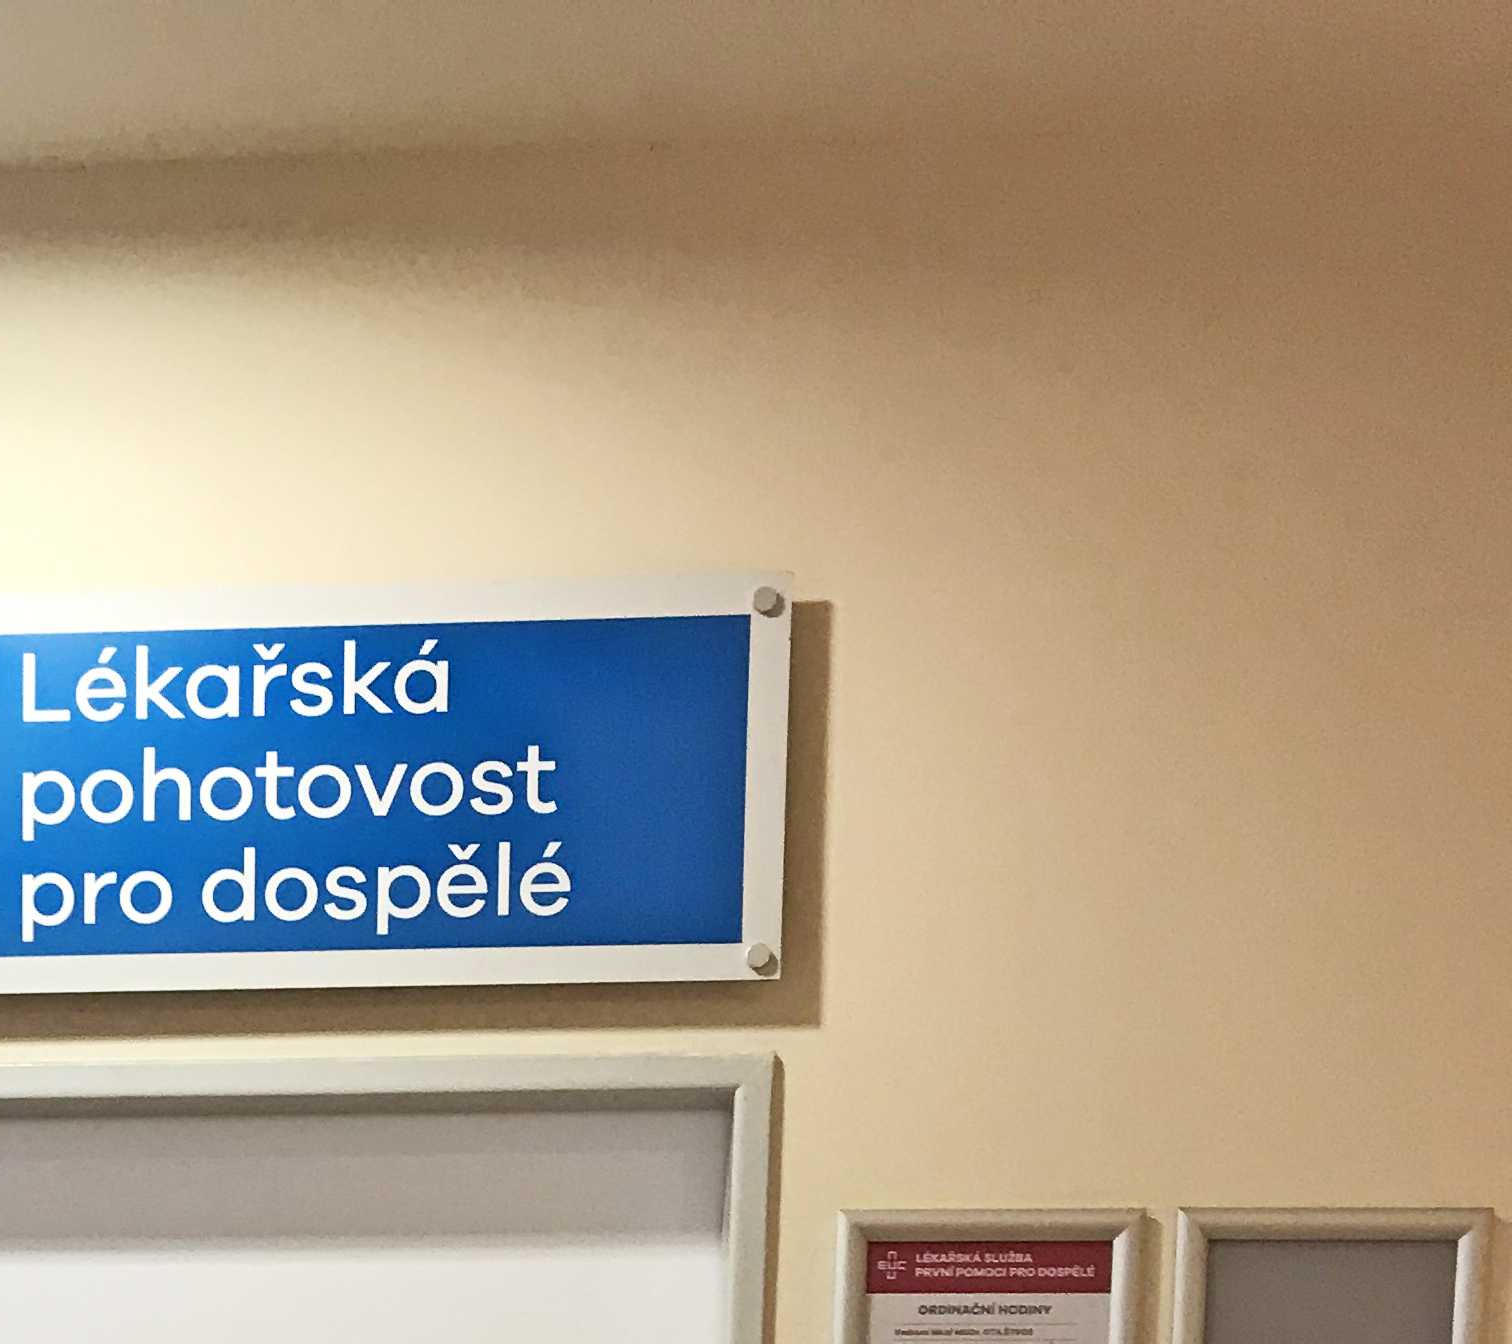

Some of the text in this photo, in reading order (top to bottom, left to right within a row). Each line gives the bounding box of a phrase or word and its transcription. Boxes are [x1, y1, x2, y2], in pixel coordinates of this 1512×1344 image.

[20, 639, 451, 726] Lékařská
[20, 743, 559, 841] pohotovost
[20, 840, 572, 944] pro dospělé
[915, 1251, 1033, 1263] LÉKAŘSKÁ SLUŽBA
[915, 1265, 1095, 1278] PRVNÍ POMOCI PRO DOSPĚLÉ
[918, 1303, 1052, 1316] ORDINAČNÍ HODINY
